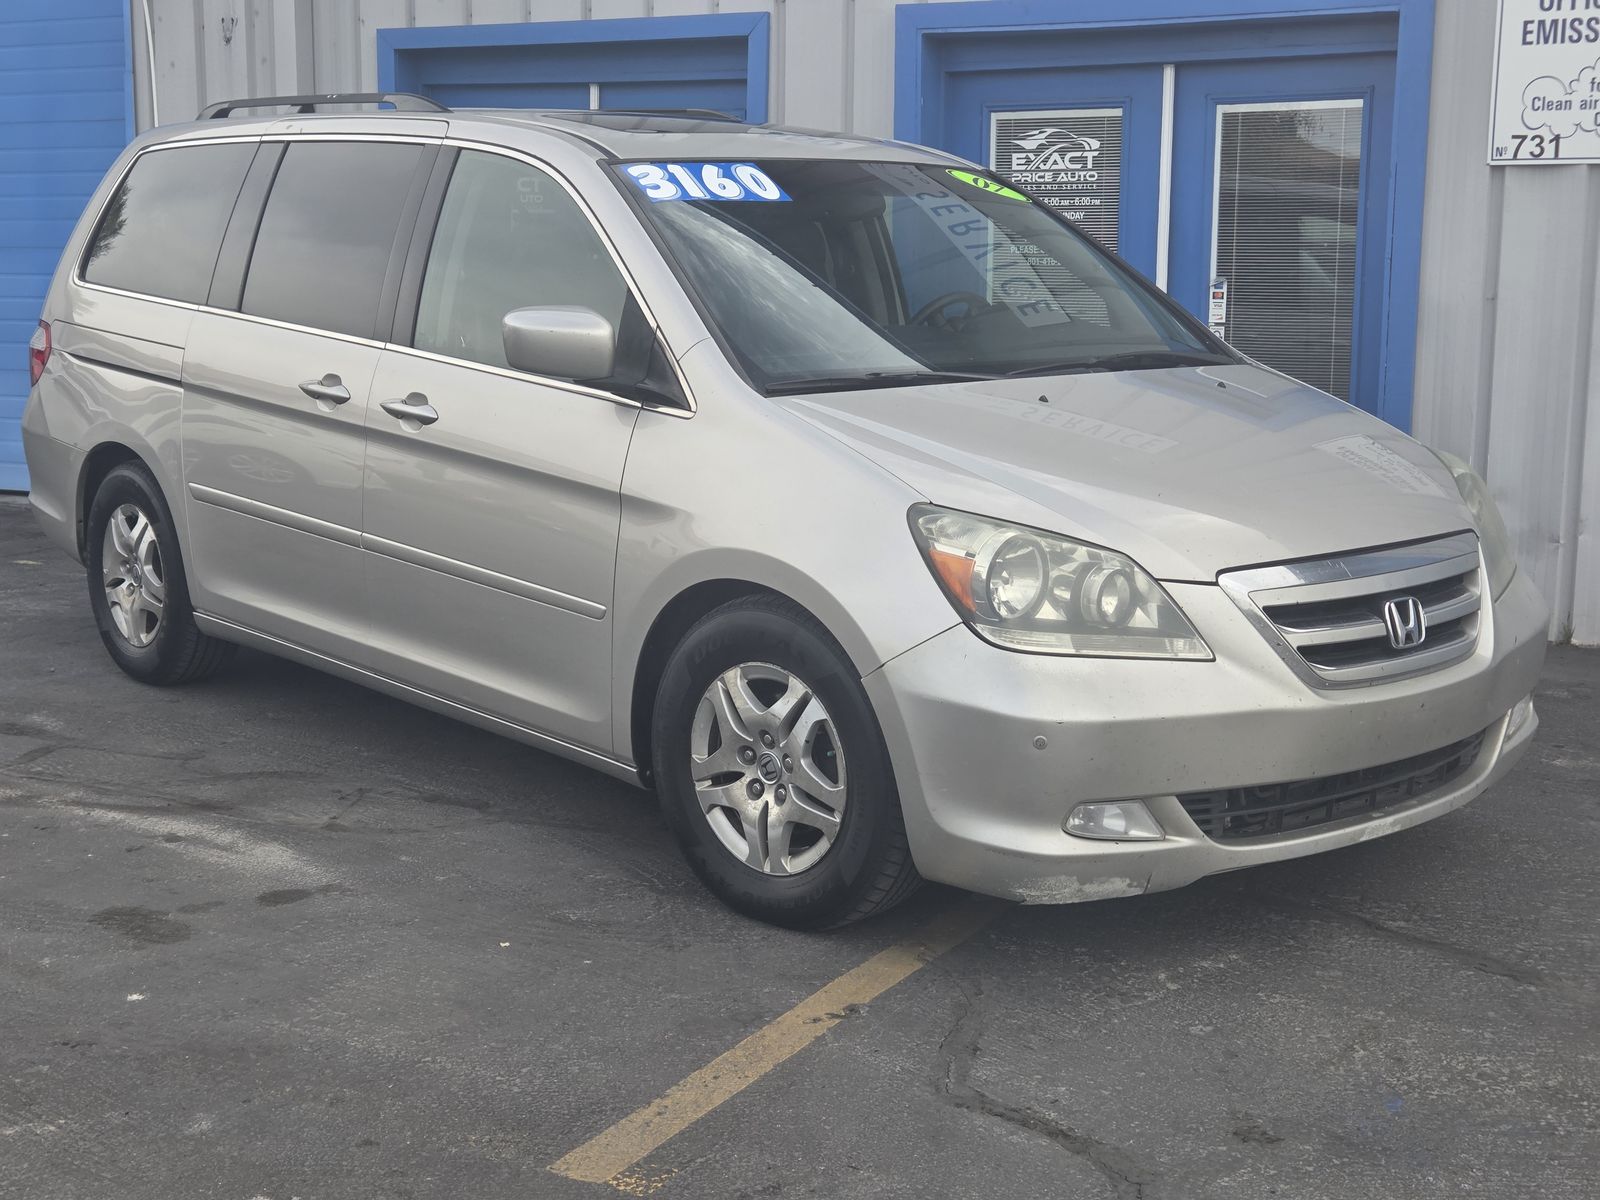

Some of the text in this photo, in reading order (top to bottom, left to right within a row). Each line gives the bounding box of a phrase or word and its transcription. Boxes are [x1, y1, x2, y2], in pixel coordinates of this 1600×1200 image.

[1521, 17, 1600, 46] EMISS
[1531, 95, 1600, 112] Clean air
[1511, 134, 1561, 160] 731
[1011, 151, 1100, 171] EXACT
[627, 164, 781, 200] 3160
[972, 177, 1005, 192] 07
[1011, 171, 1099, 183] PRICE AUTO
[1062, 211, 1085, 220] NDAY
[1010, 244, 1039, 254] PLEASE
